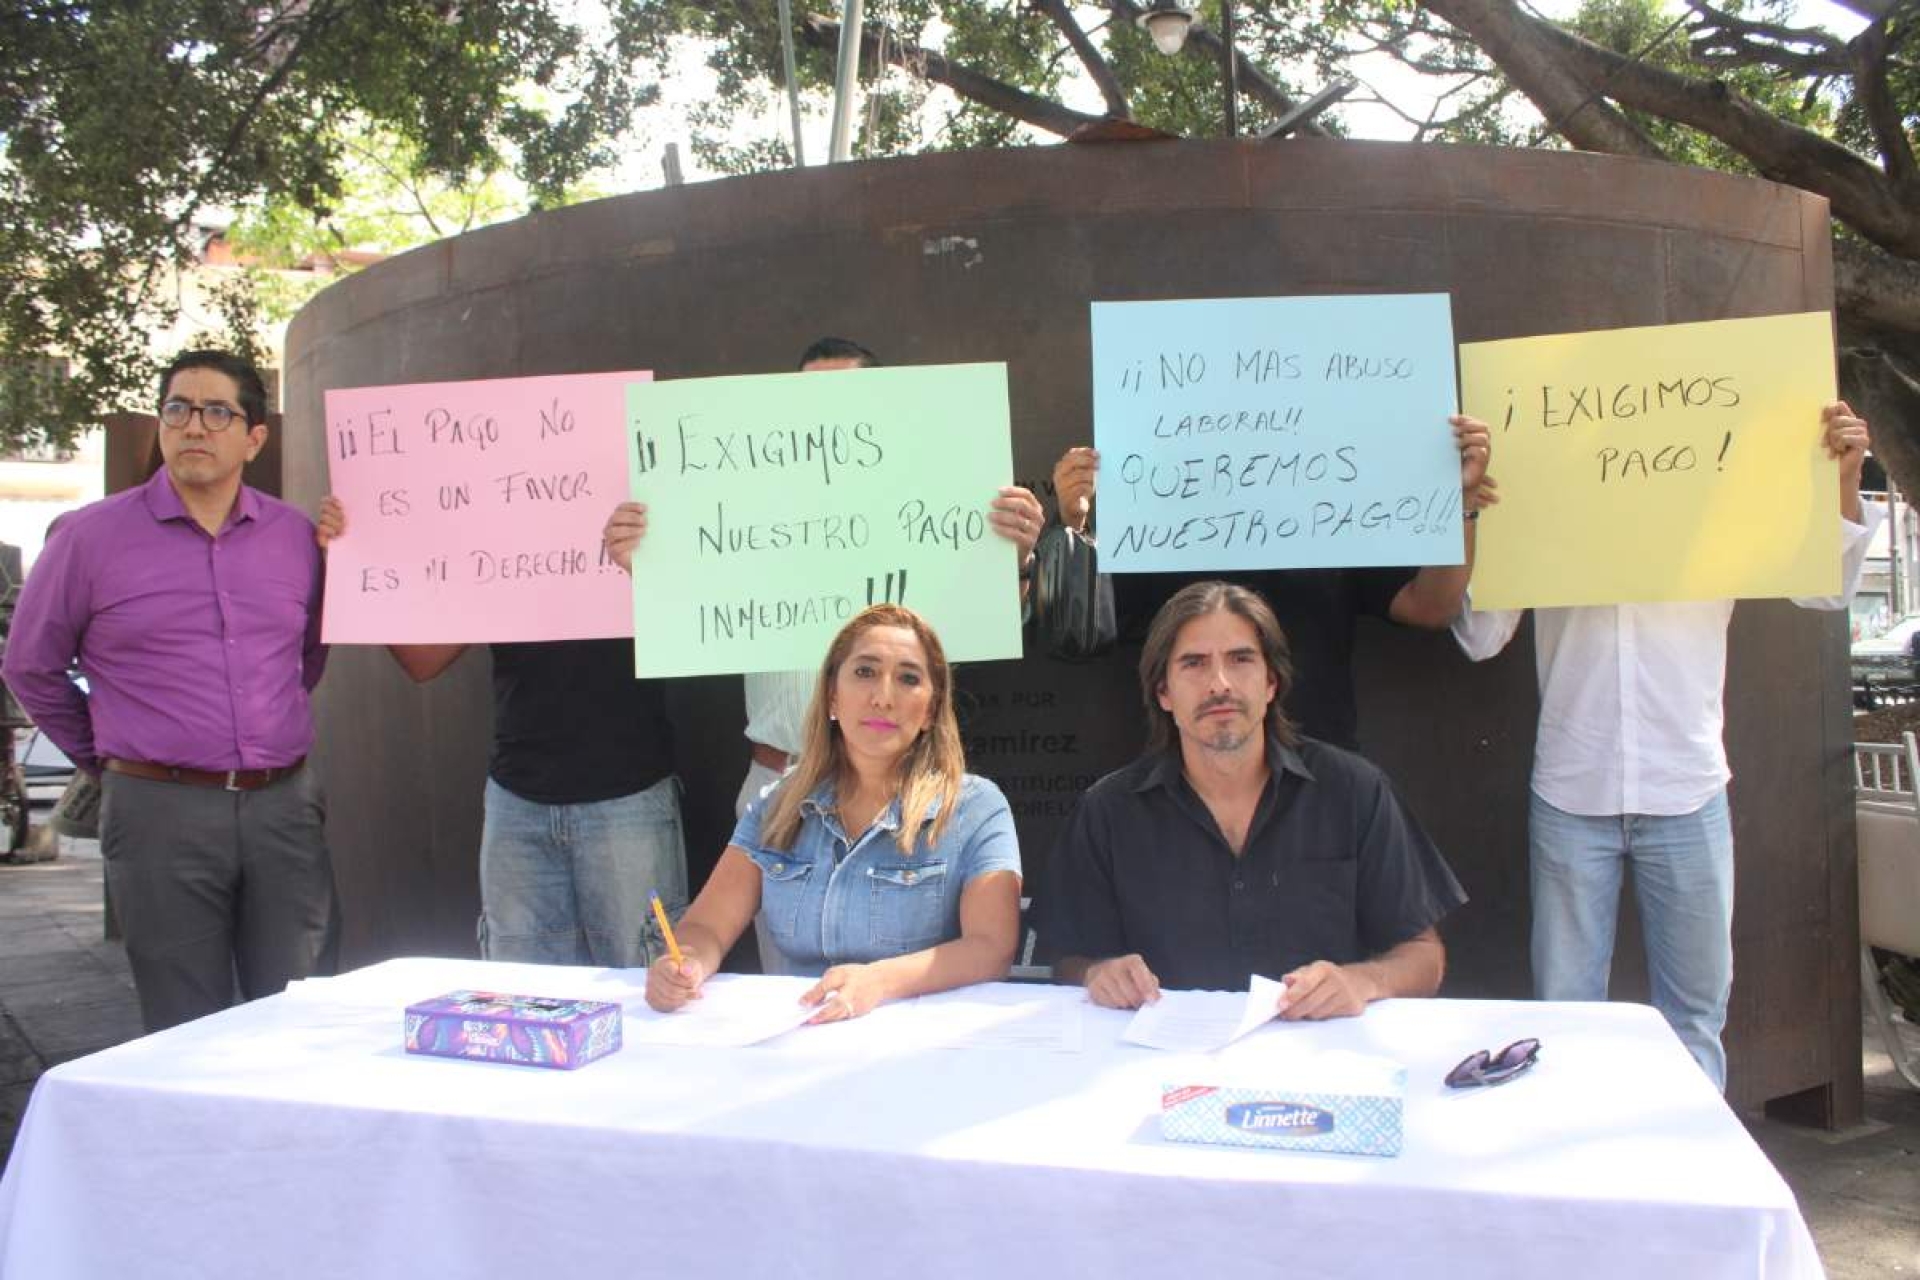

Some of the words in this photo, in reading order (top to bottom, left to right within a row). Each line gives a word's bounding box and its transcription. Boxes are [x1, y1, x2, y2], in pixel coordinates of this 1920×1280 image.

[1235, 350, 1302, 384] MAS
[1325, 351, 1414, 384] ABUSO
[424, 408, 500, 451] PAGO
[539, 397, 576, 440] NO
[1154, 406, 1304, 438] LABORAL!!
[1121, 446, 1359, 500] QUEREMOS
[379, 489, 412, 517] ES
[699, 501, 870, 556] NUESTRO
[899, 499, 985, 551] PAGO
[361, 566, 400, 593] ES
[1242, 1107, 1320, 1130] Linnette
